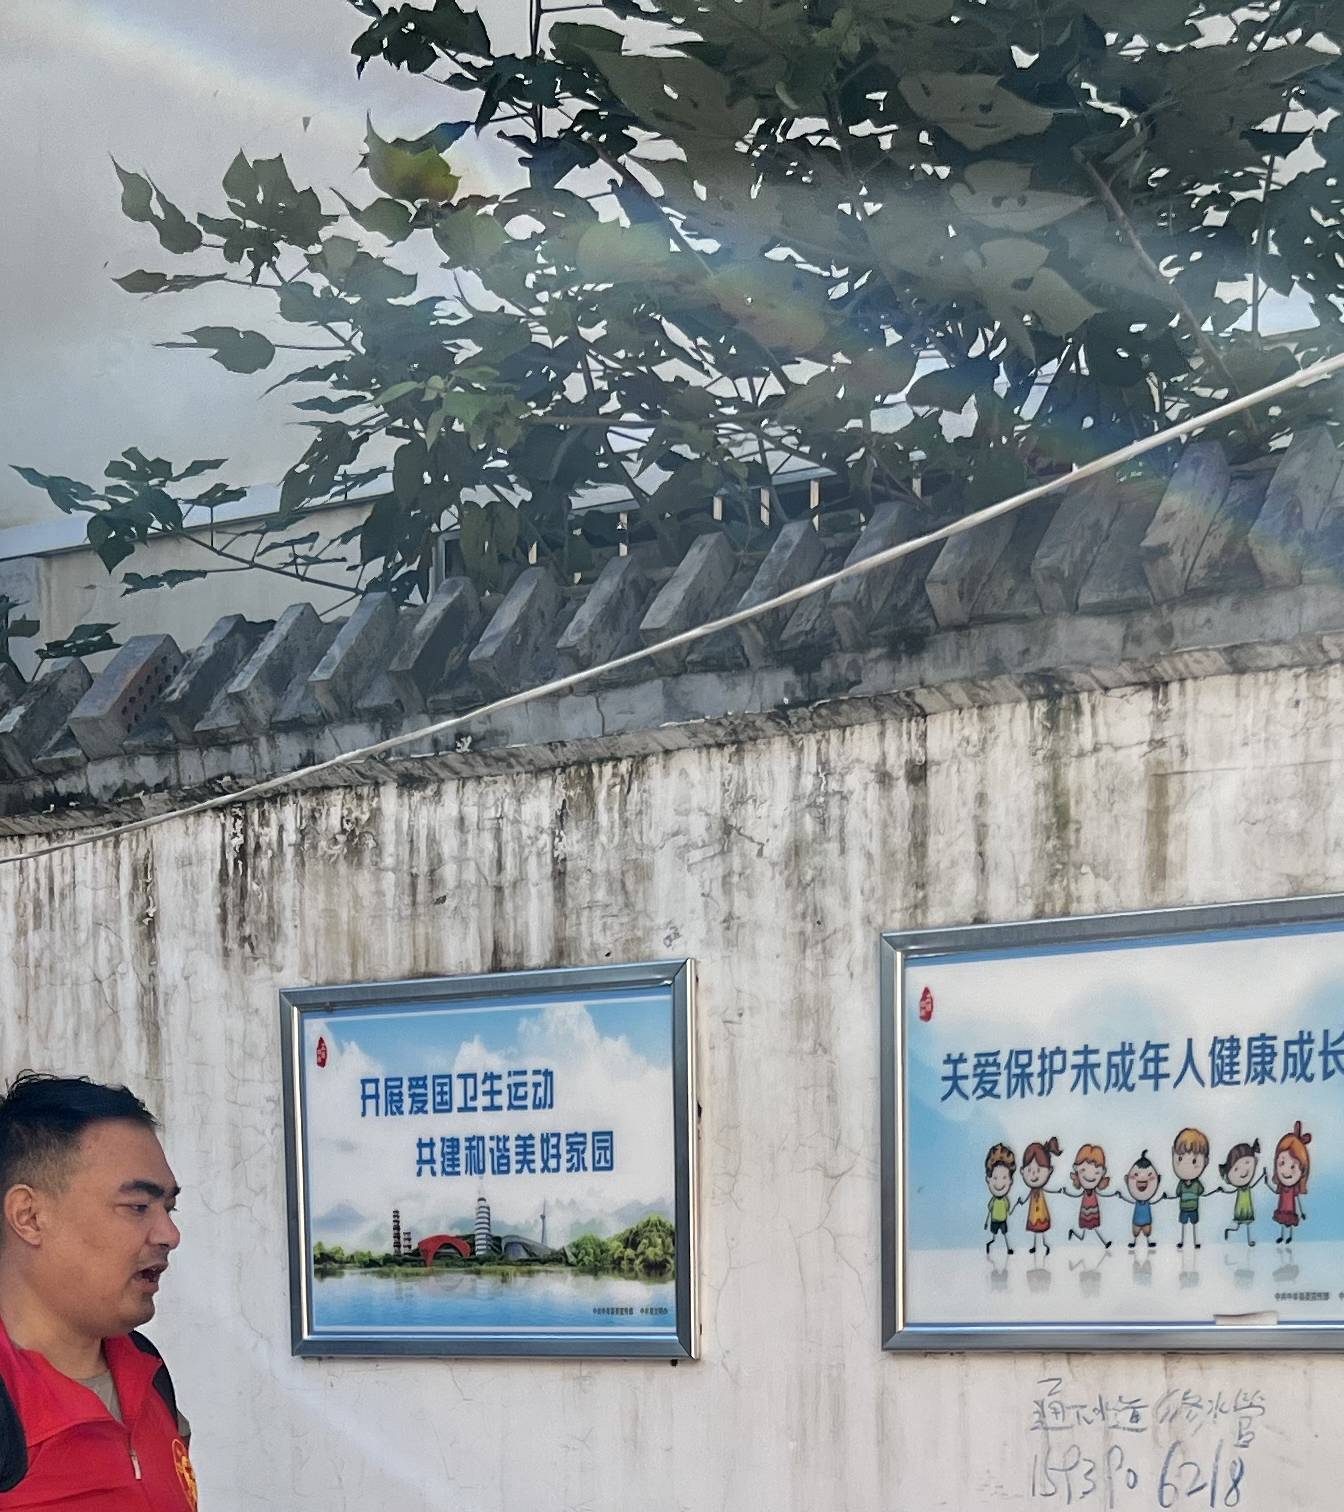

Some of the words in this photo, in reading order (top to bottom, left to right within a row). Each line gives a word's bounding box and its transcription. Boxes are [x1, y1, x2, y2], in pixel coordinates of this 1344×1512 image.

[360, 1068, 555, 1117] 开展爱国卫生运动
[416, 1130, 615, 1177] 共建和谐美好家园
